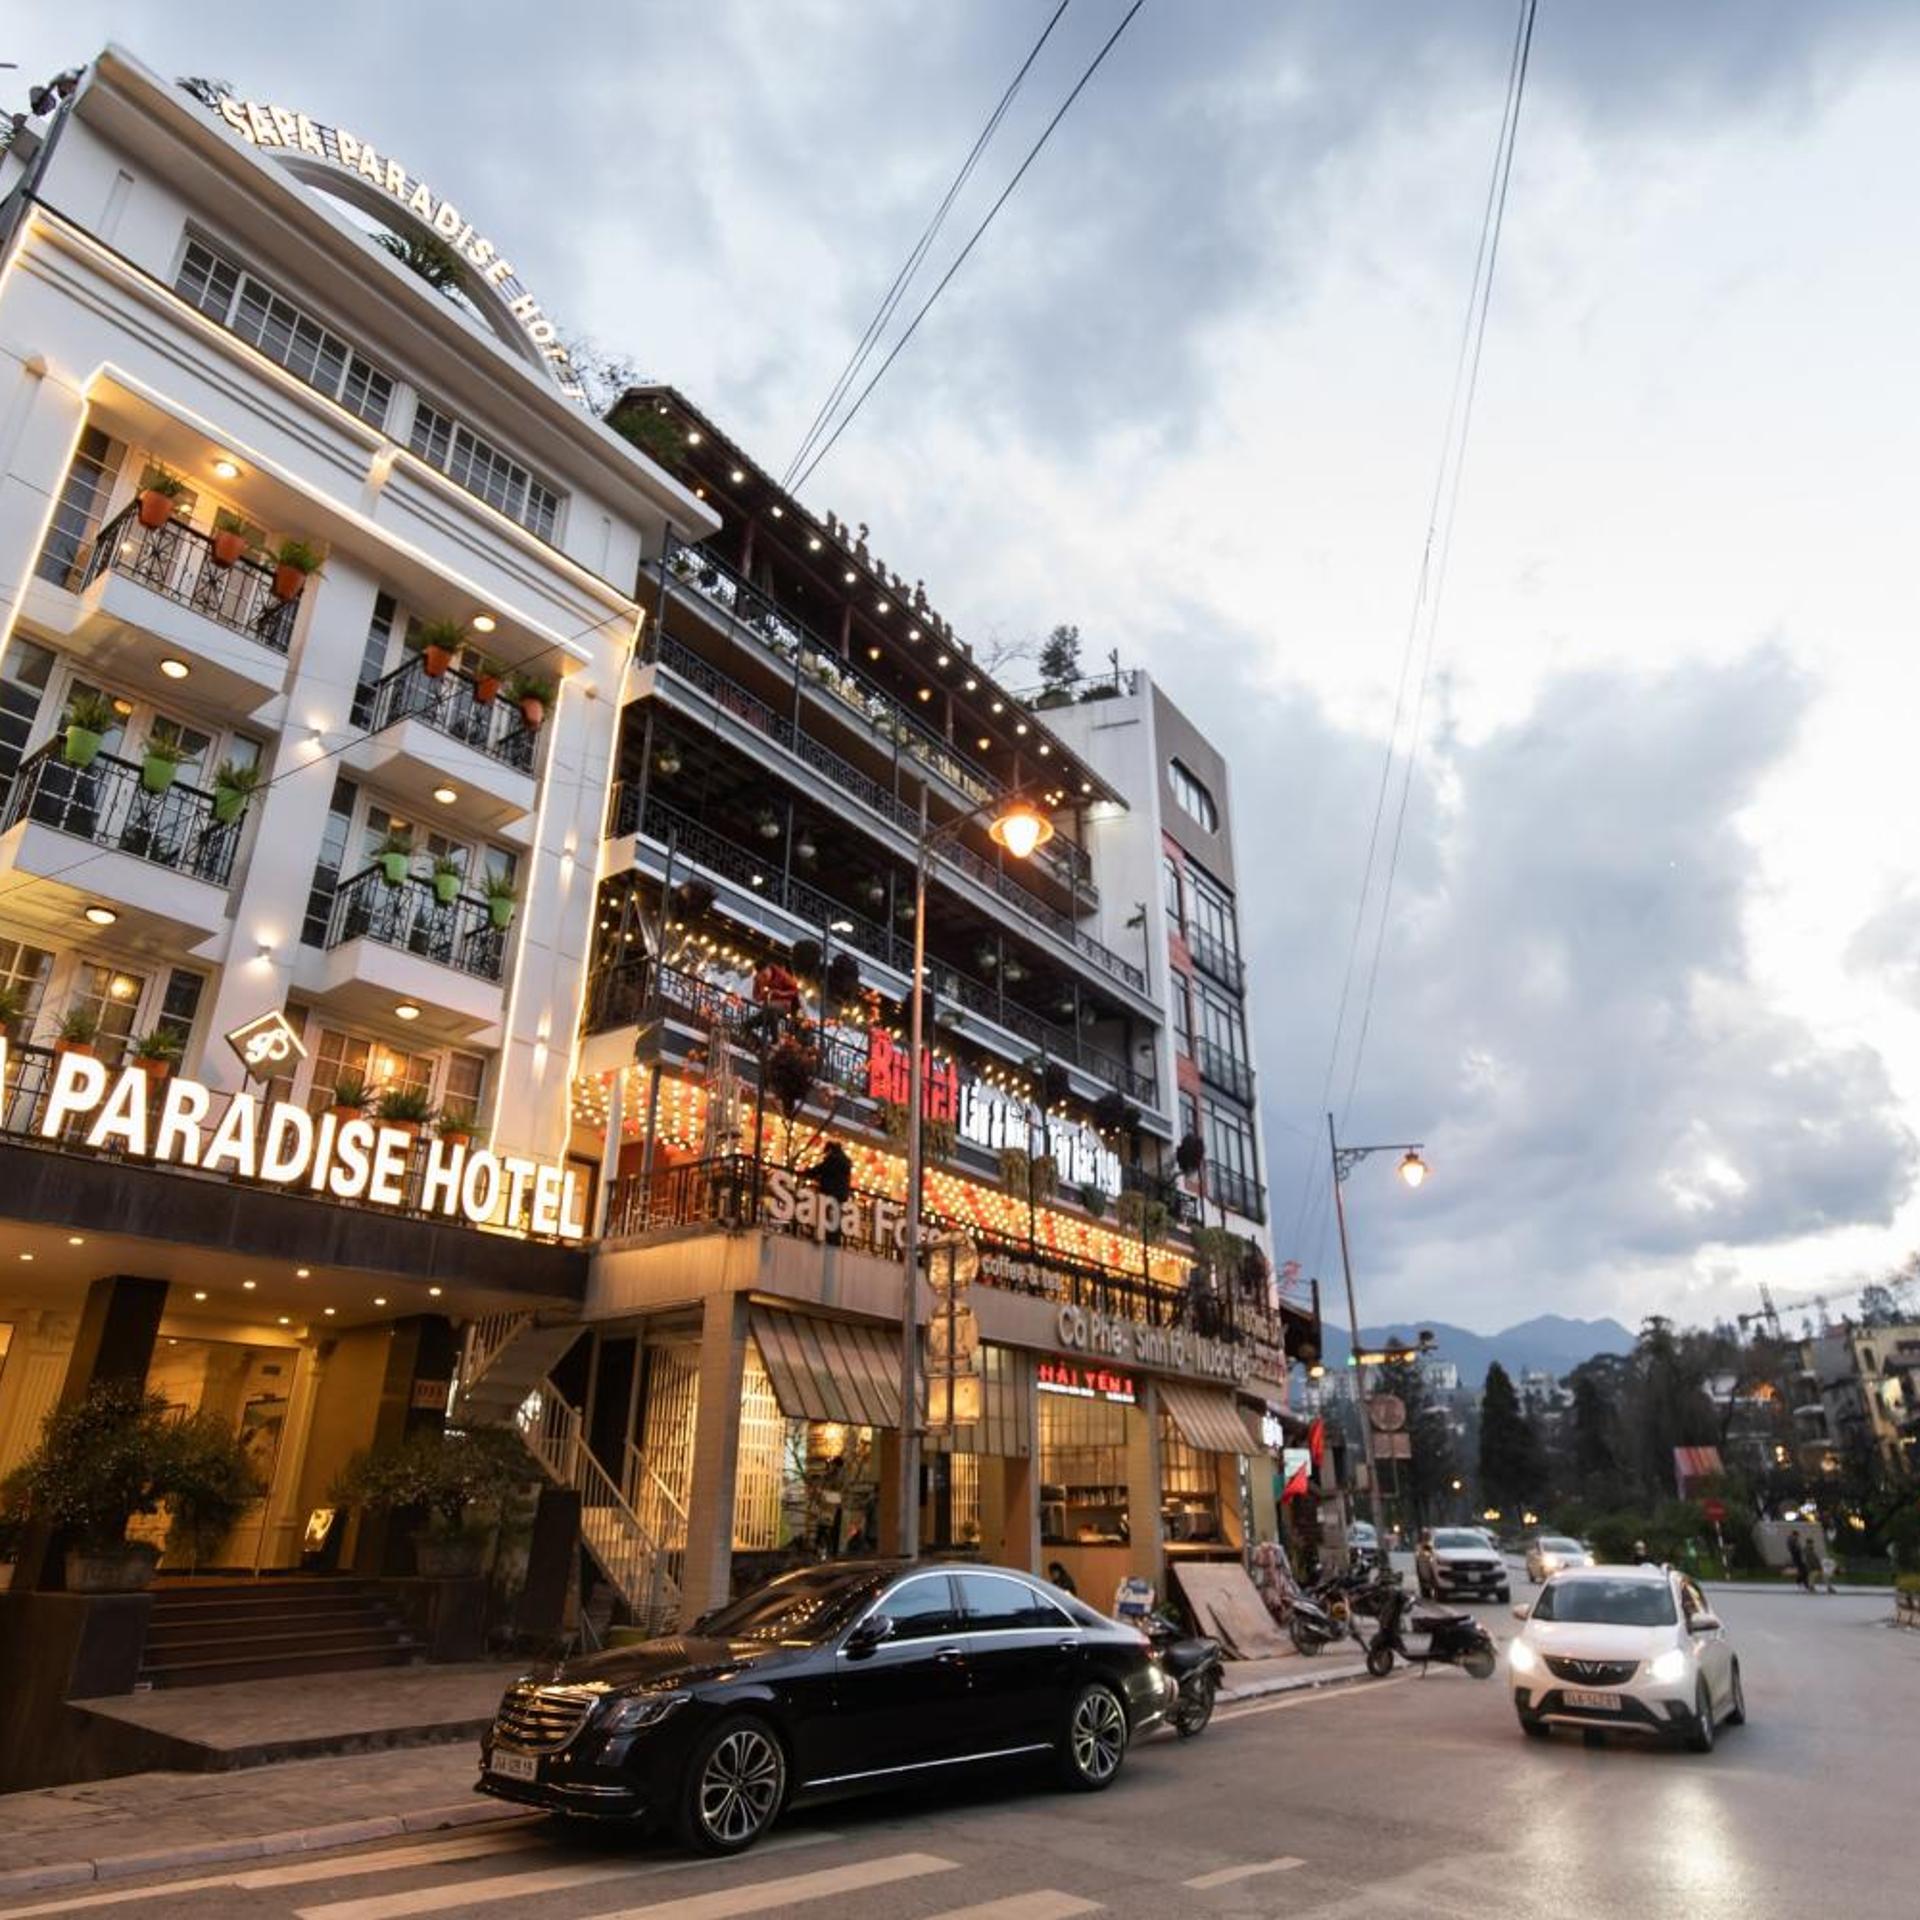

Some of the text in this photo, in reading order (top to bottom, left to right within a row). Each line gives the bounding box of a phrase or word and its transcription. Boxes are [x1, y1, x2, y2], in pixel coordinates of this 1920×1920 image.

[218, 93, 326, 158] SAPA
[335, 128, 515, 284] PARADISE
[41, 1052, 412, 1205] PARADISE
[421, 1138, 584, 1239] HOTEL
[768, 1168, 861, 1242] Sapa
